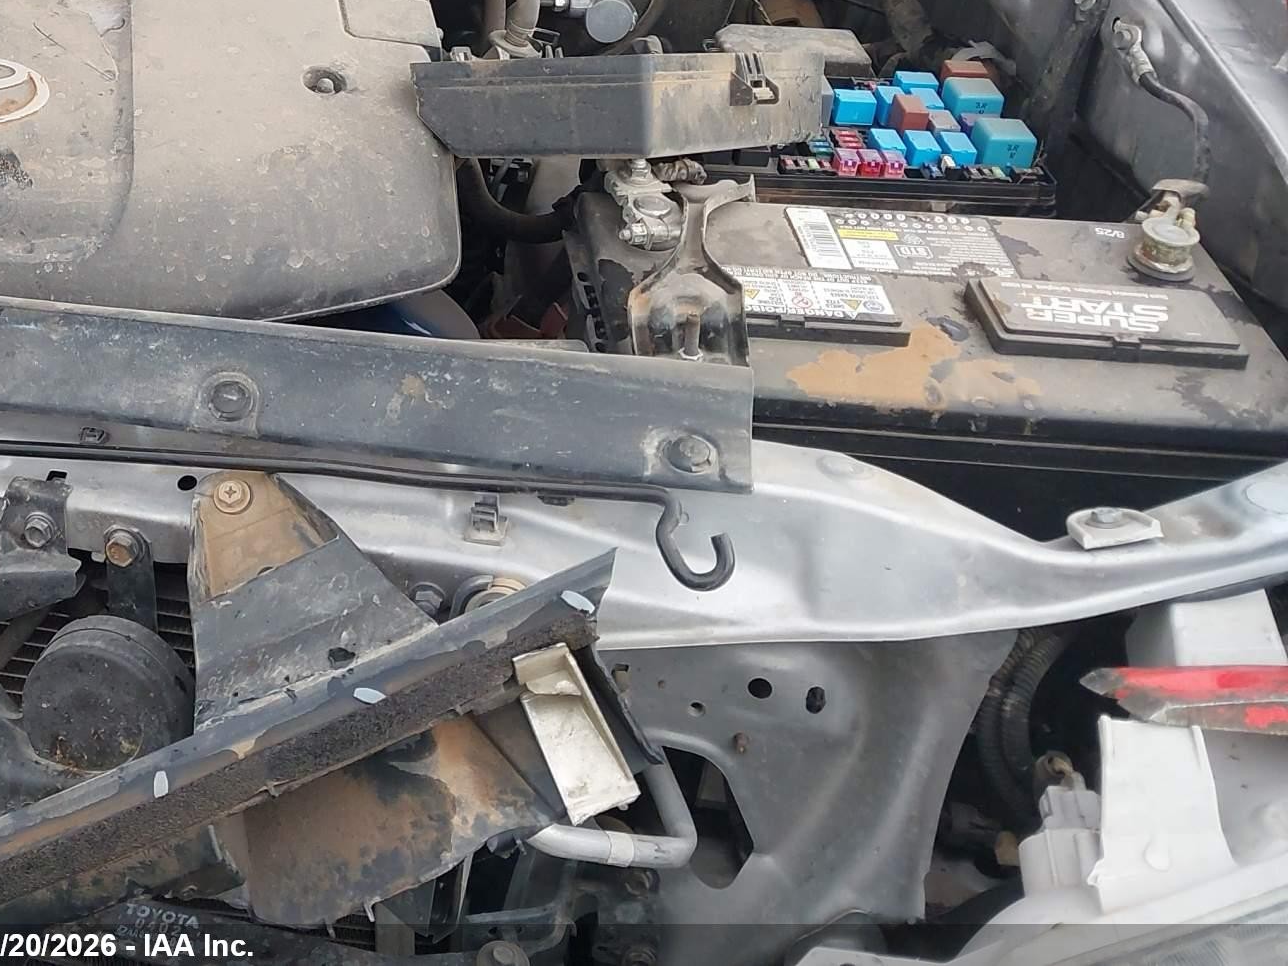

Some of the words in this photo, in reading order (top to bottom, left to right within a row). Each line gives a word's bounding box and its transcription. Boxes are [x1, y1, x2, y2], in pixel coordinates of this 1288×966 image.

[1095, 227, 1125, 239] 8/25
[745, 305, 845, 319] DANGER/POISO
[1025, 308, 1160, 333] SUPER
[125, 903, 199, 929] TOYOTA
